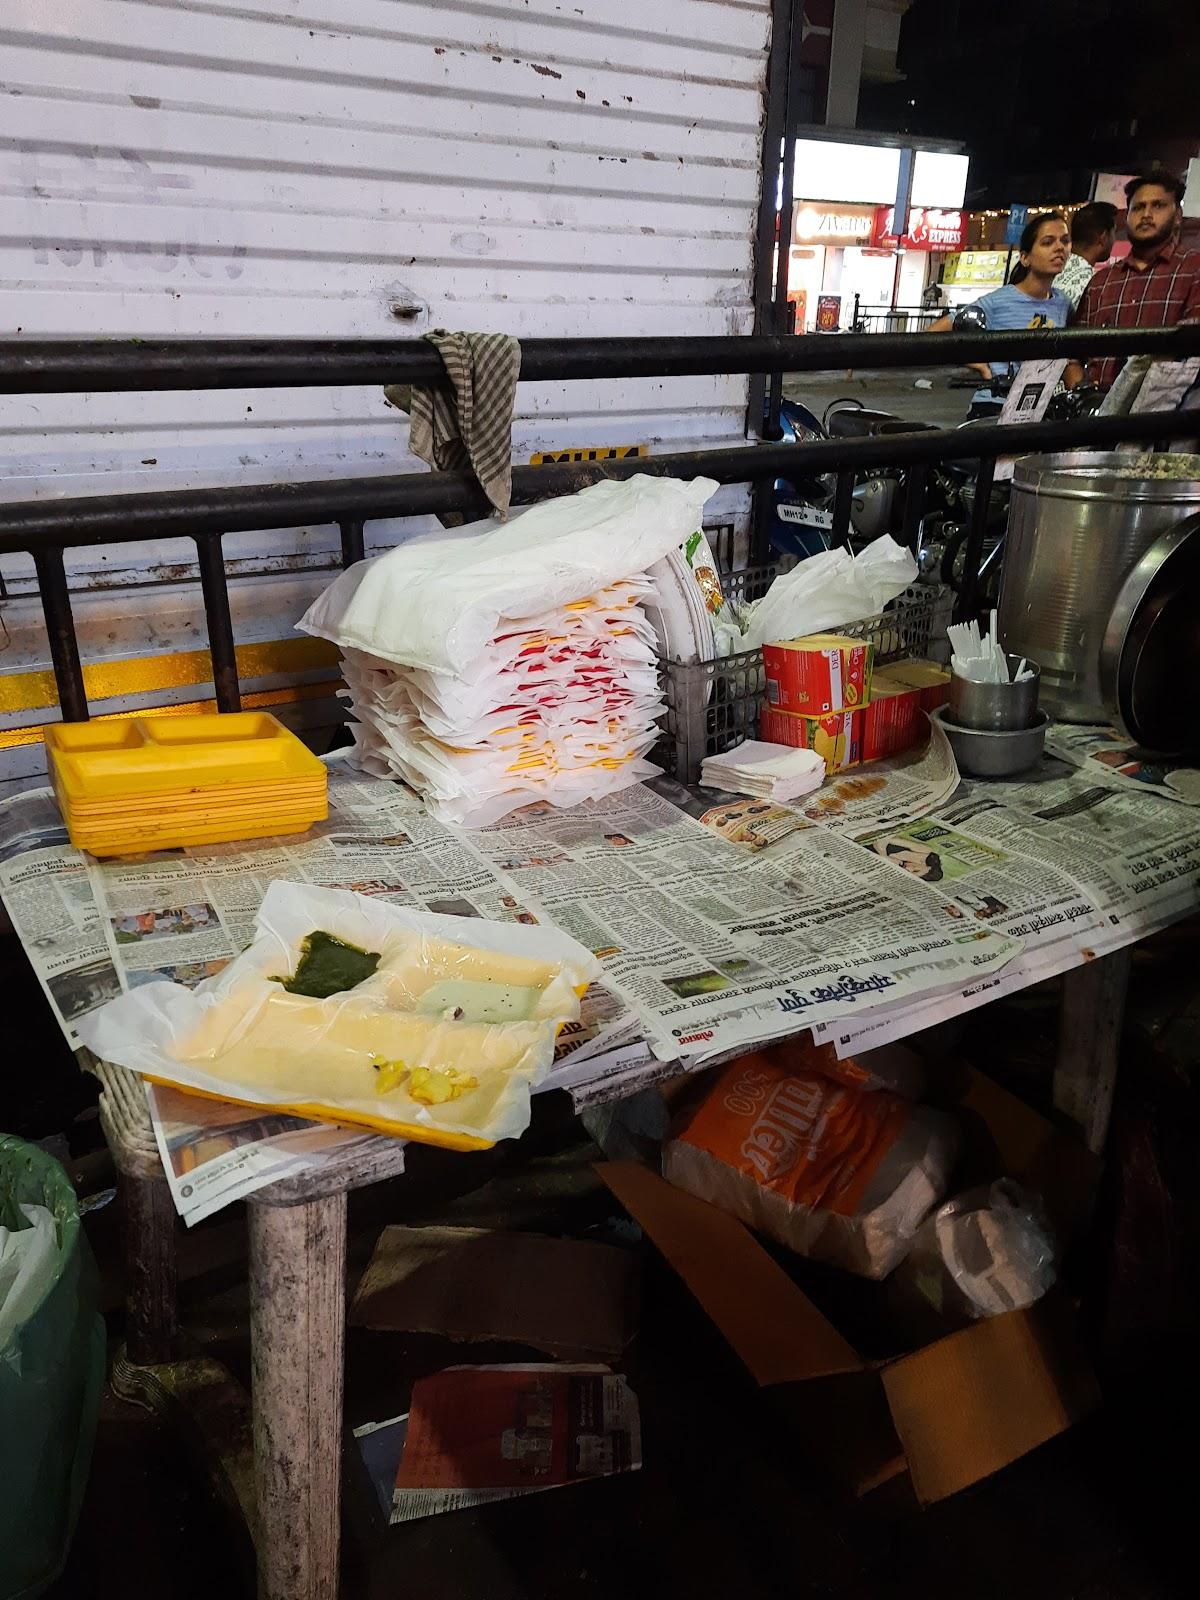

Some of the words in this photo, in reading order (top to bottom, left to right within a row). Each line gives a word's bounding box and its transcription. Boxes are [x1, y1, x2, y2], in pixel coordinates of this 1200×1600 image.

[928, 229, 962, 244] EXPRESS
[809, 968, 898, 1008] सांस्कृतिक
[658, 1001, 691, 1017] रहस्य
[776, 989, 813, 1015] पुणे
[677, 1028, 715, 1048] लोकमत
